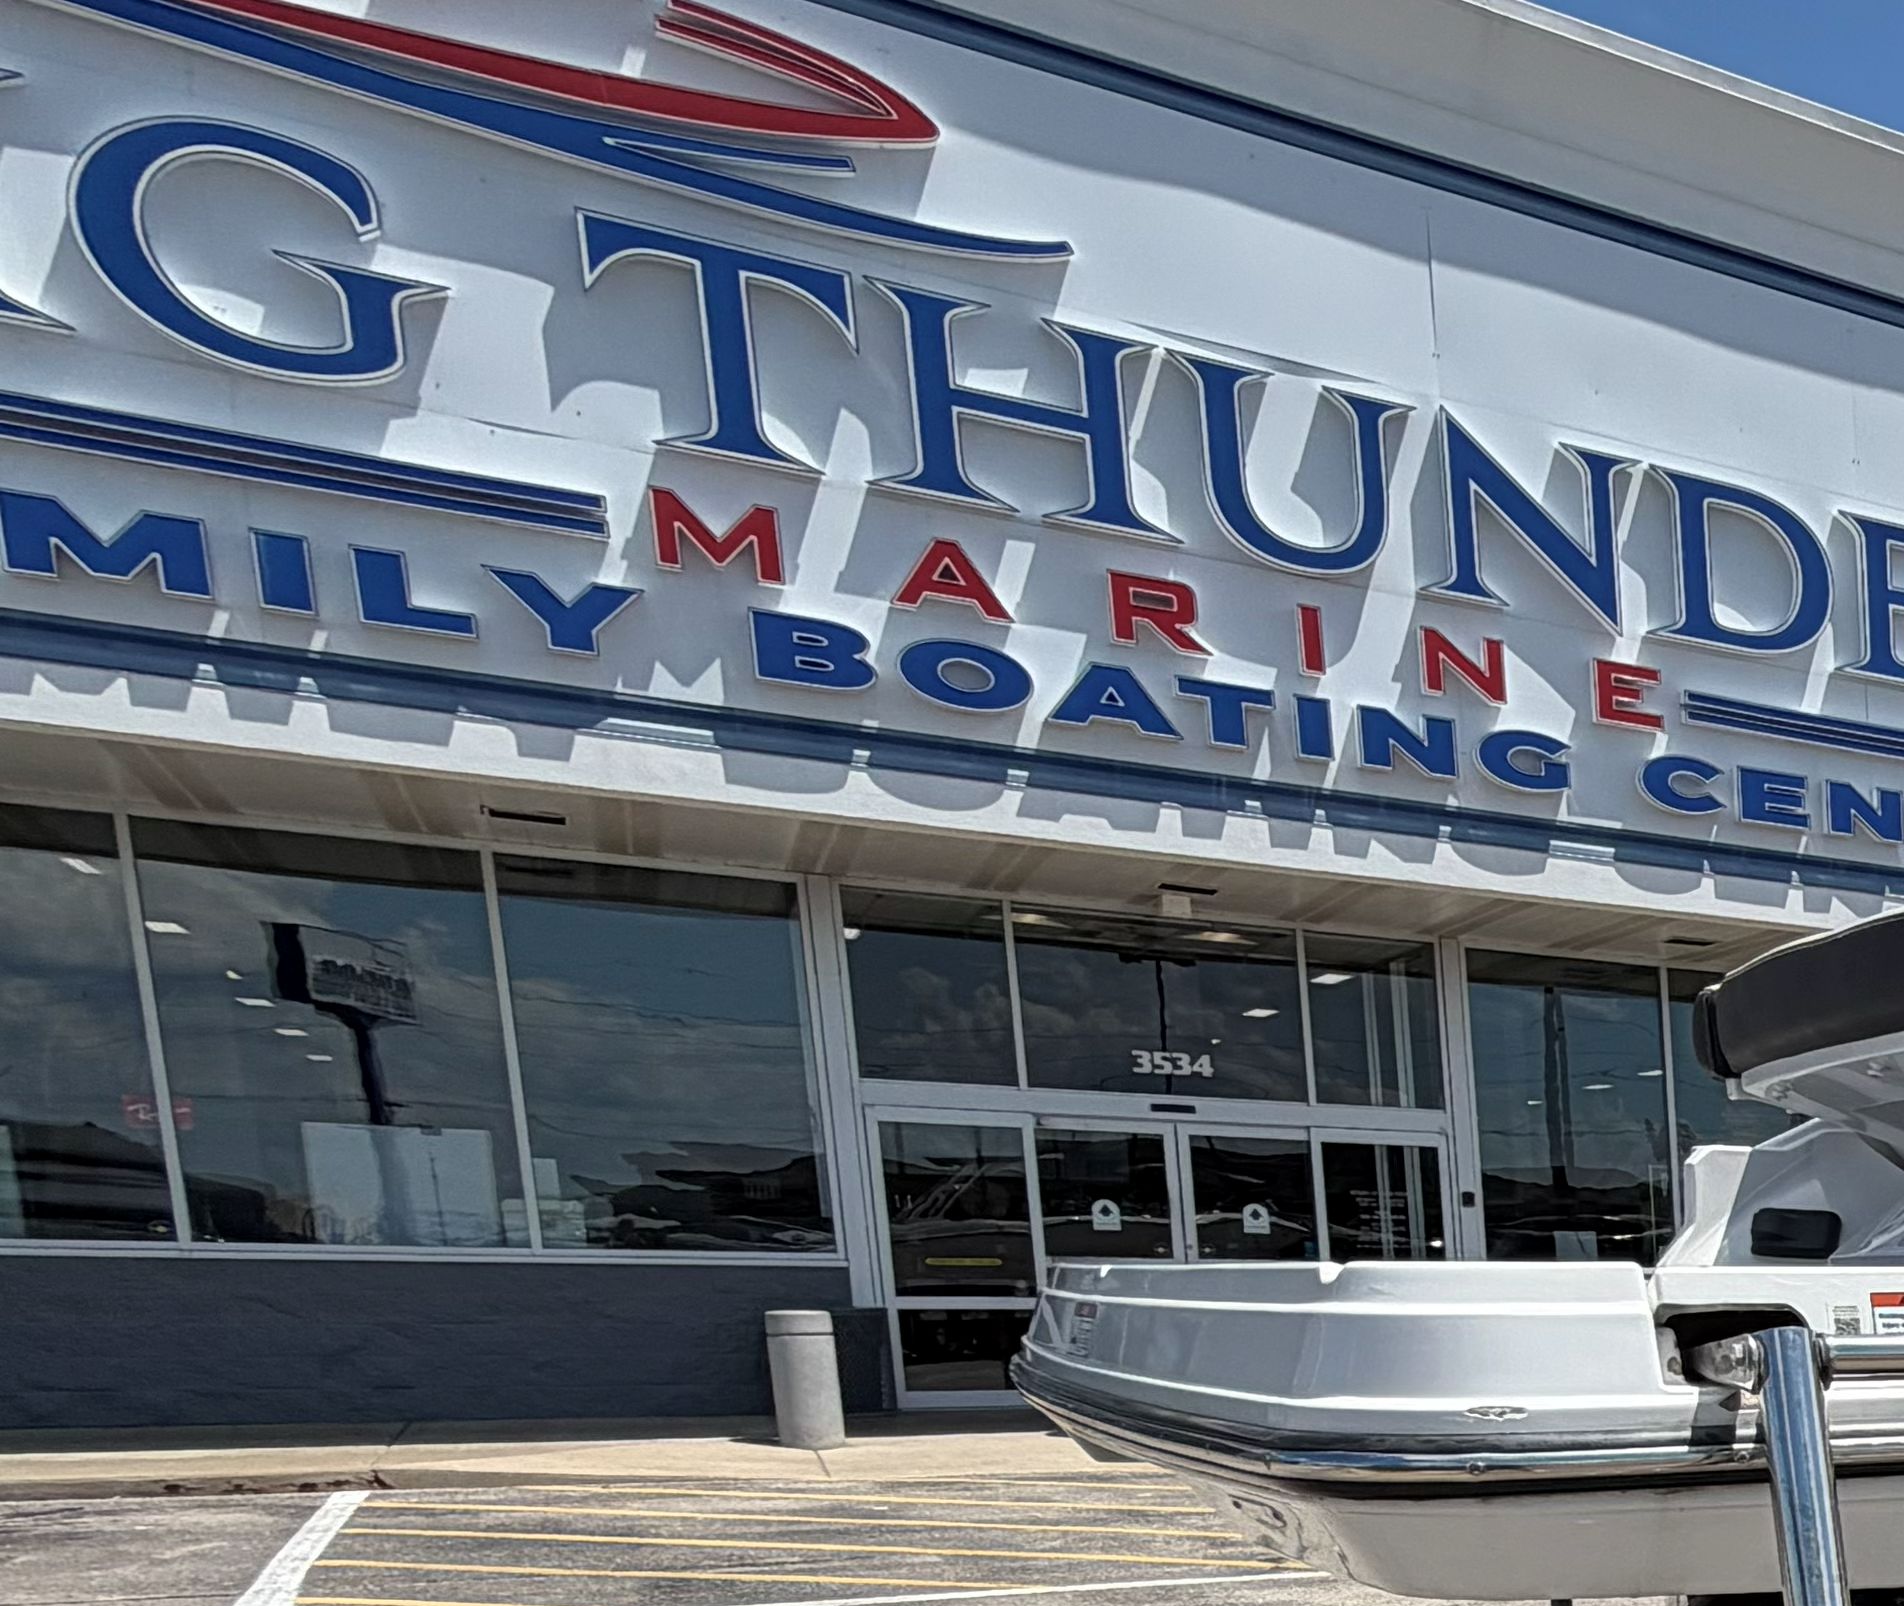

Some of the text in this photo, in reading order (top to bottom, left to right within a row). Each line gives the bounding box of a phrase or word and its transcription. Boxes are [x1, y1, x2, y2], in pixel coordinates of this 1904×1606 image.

[0, 70, 452, 387] G
[0, 487, 645, 657] MILY
[747, 606, 1573, 792] BOATING
[649, 487, 1666, 731] MARINE
[1131, 1049, 1215, 1077] 3534
